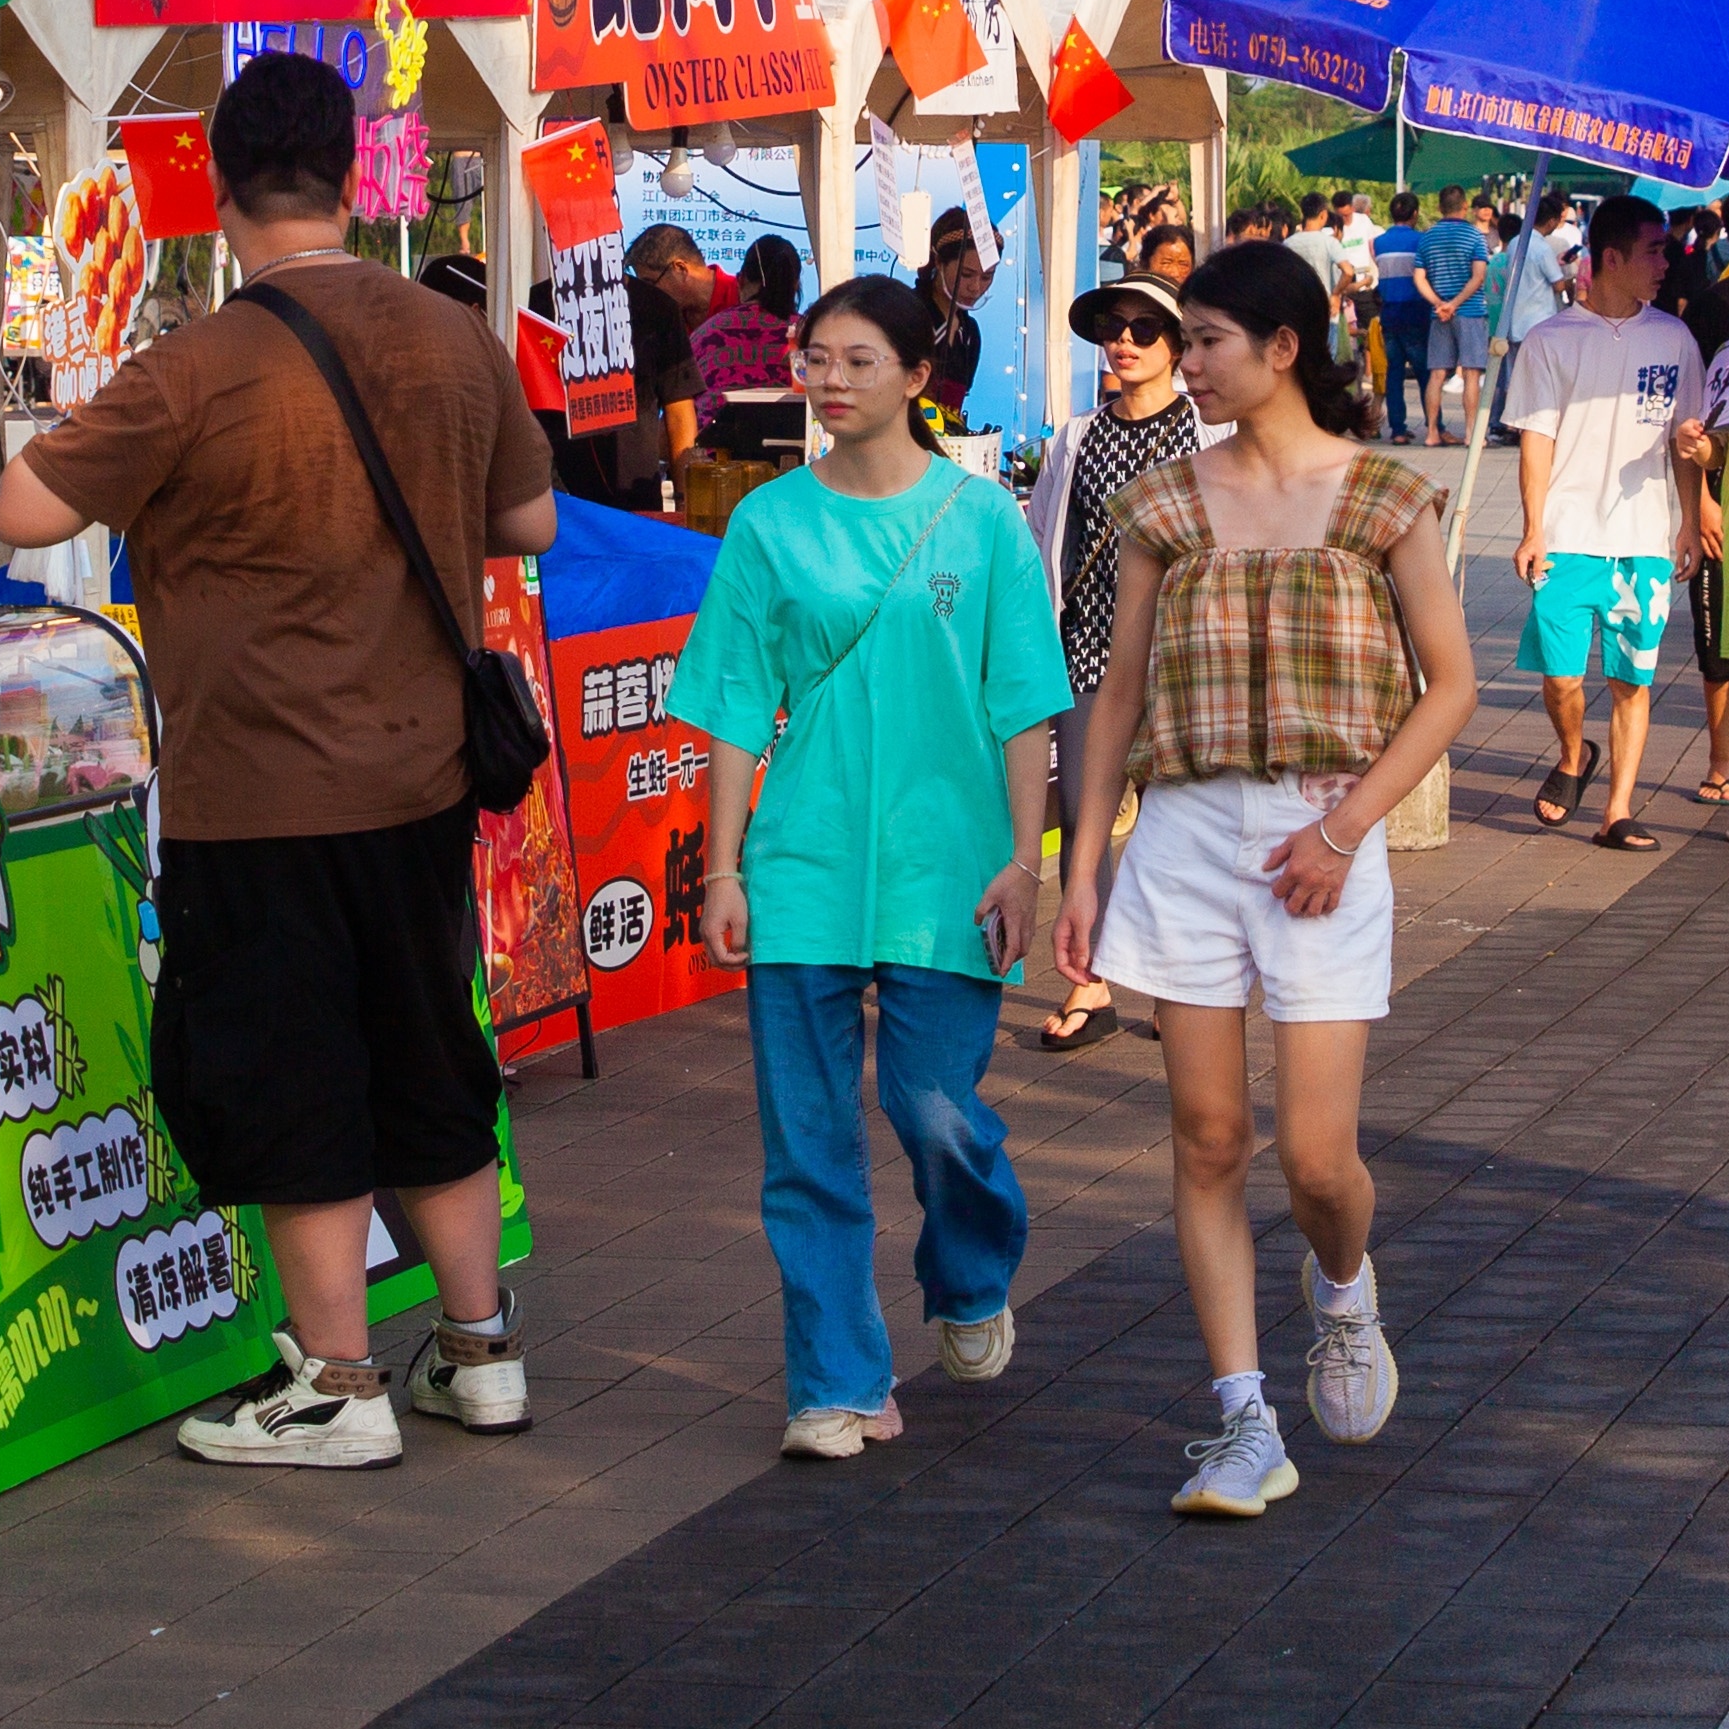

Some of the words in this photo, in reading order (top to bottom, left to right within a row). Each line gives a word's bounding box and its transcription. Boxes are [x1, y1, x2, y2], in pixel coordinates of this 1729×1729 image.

[644, 56, 730, 110] OYSTER
[733, 48, 828, 100] CLASSMATE
[589, 894, 646, 955] 鲜活
[27, 1133, 148, 1226] 纯手工制作
[126, 1232, 233, 1328] 清凉解暑
